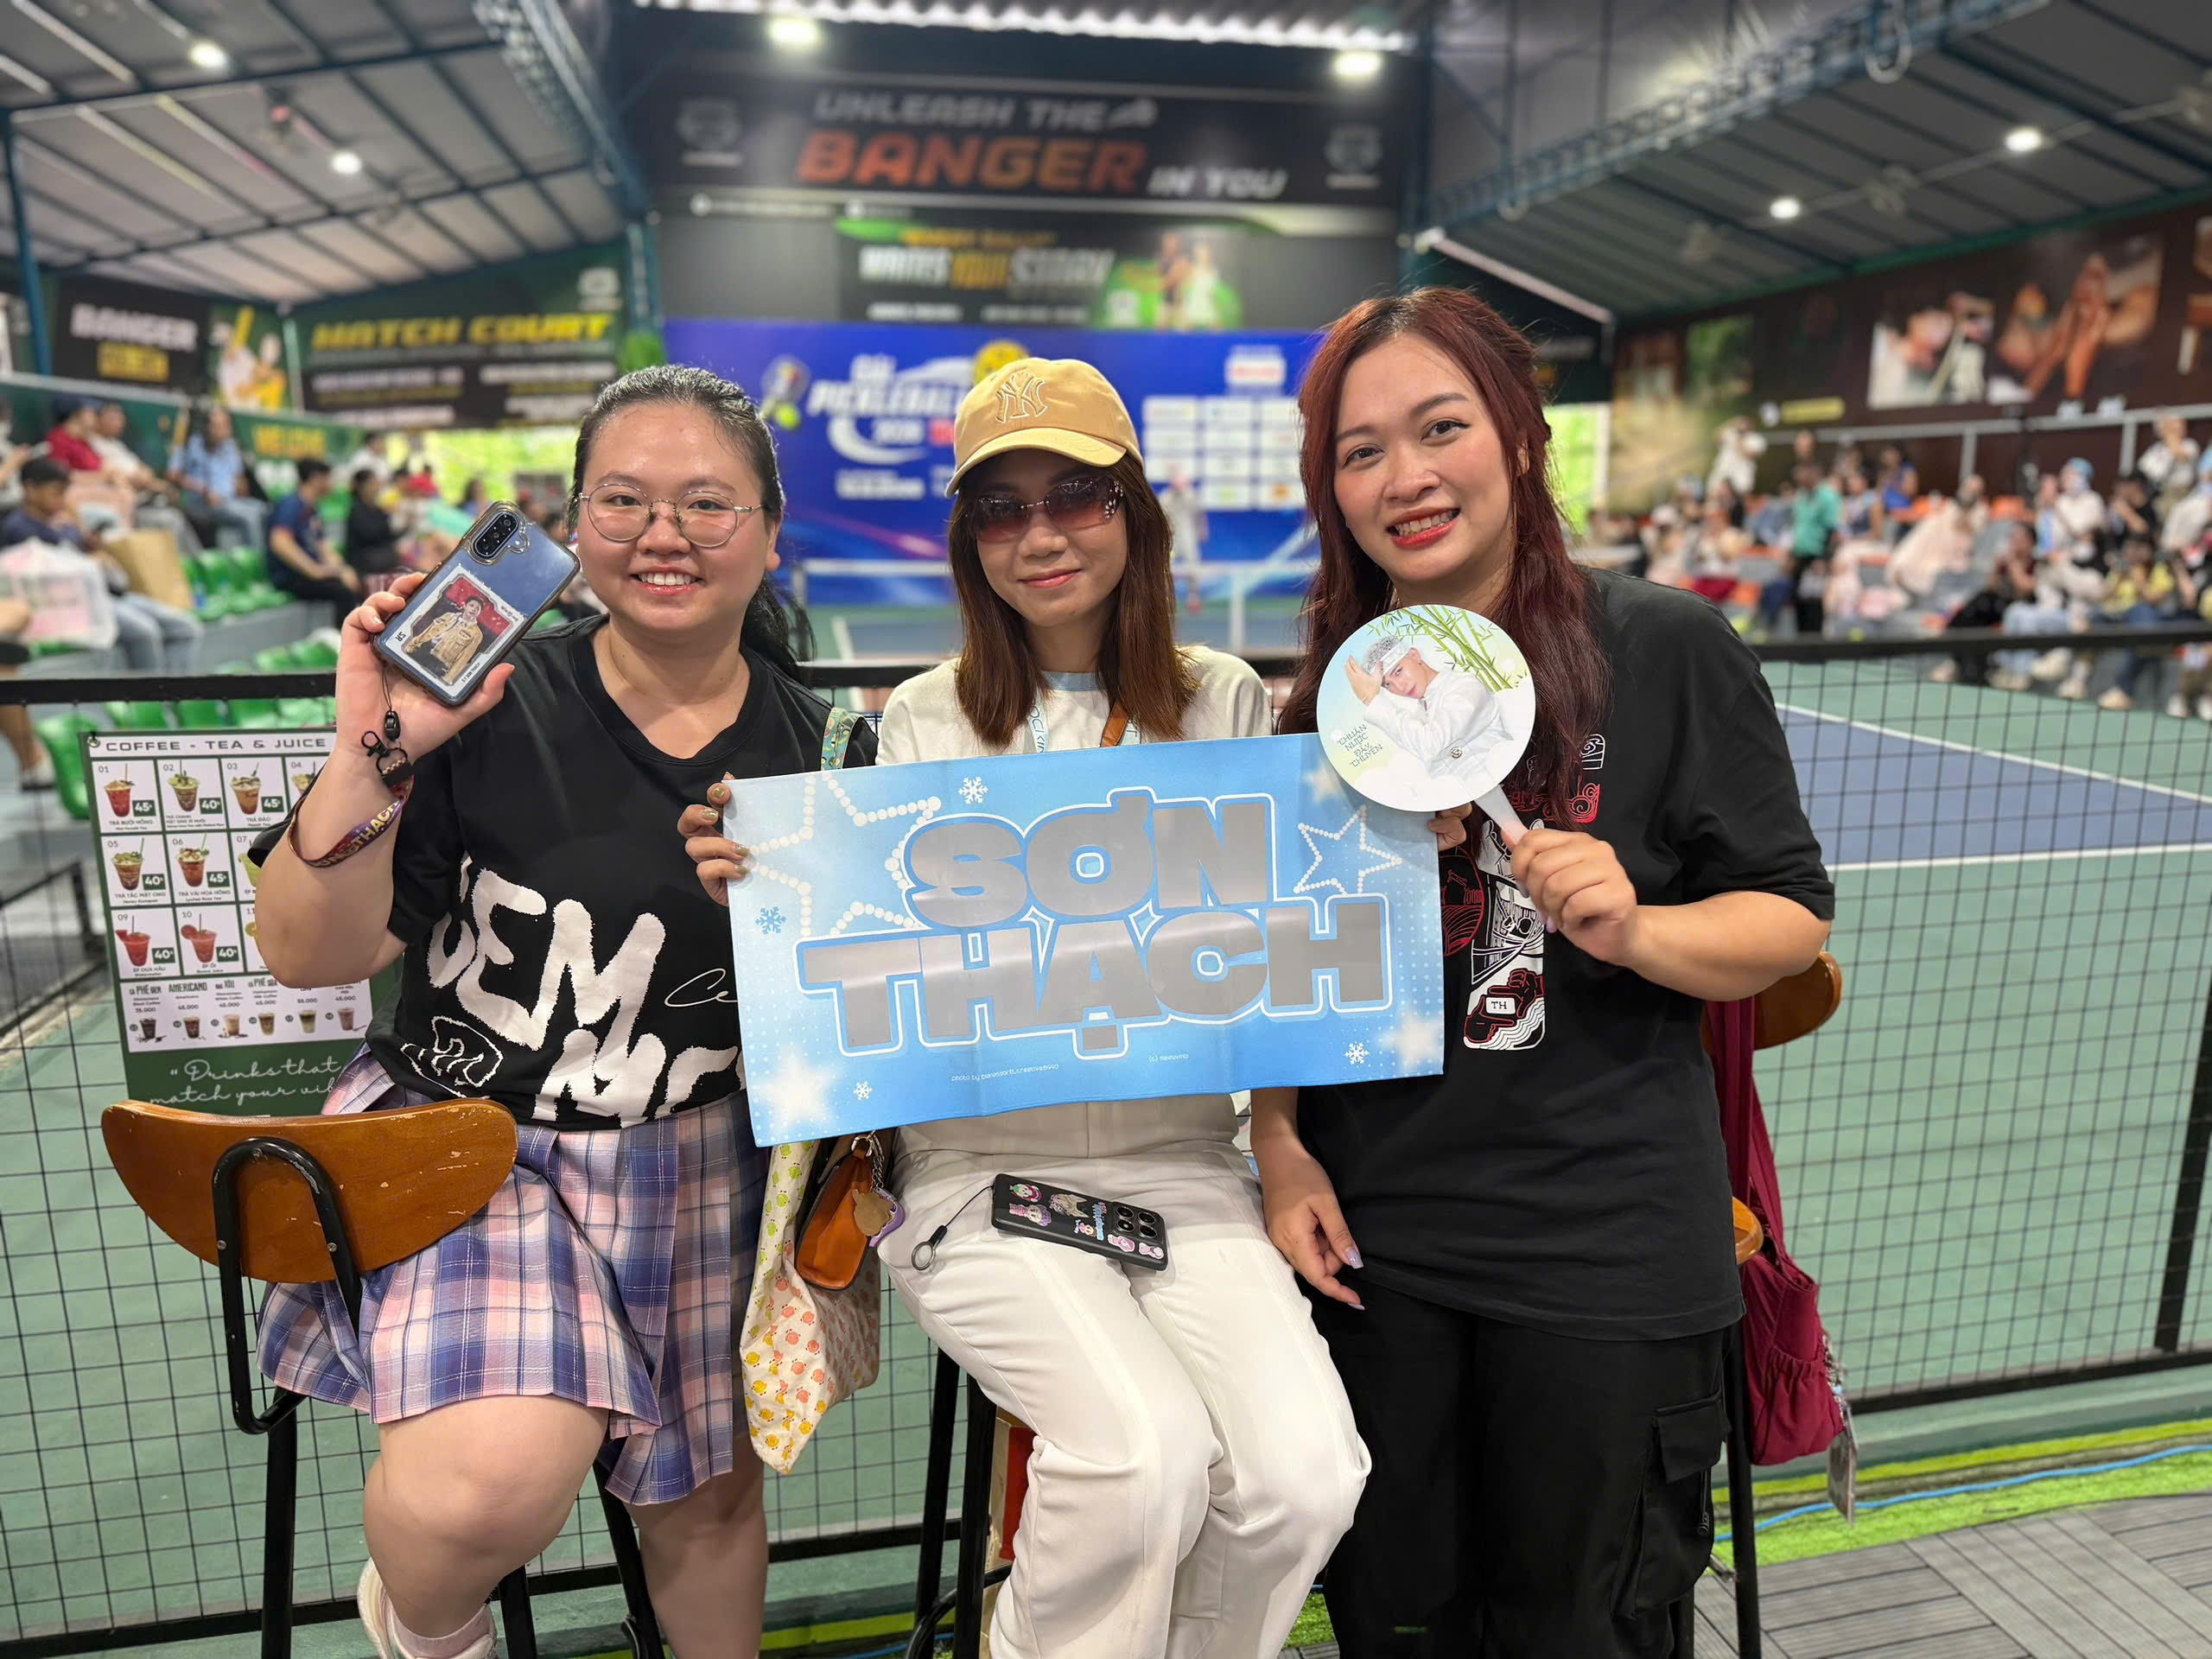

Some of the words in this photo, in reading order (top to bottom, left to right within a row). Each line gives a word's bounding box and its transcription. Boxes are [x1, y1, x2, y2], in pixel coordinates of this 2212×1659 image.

[814, 92, 1015, 128] UNLEASH
[1026, 99, 1108, 130] THE
[796, 130, 1147, 192] BANGER
[1147, 167, 1200, 197] IN
[1206, 168, 1289, 199] YOU
[311, 316, 462, 350] MATCH
[467, 311, 615, 344] COURT
[995, 372, 1048, 423] NY
[395, 631, 406, 642] SR
[106, 741, 180, 752] COFFEE
[205, 740, 244, 750] TEA
[253, 740, 265, 749] &
[275, 739, 326, 749] JUICE
[98, 766, 110, 774] 01
[162, 764, 175, 772] 02
[226, 762, 238, 771] 03
[907, 789, 1270, 930] SƠN
[168, 982, 207, 993] AMERICANO
[801, 899, 1386, 1053] THẠCH
[1491, 1001, 1507, 1010] TH
[281, 1056, 341, 1076] that
[150, 1084, 231, 1104] match
[235, 1086, 296, 1106] your
[301, 1077, 335, 1094] vib
